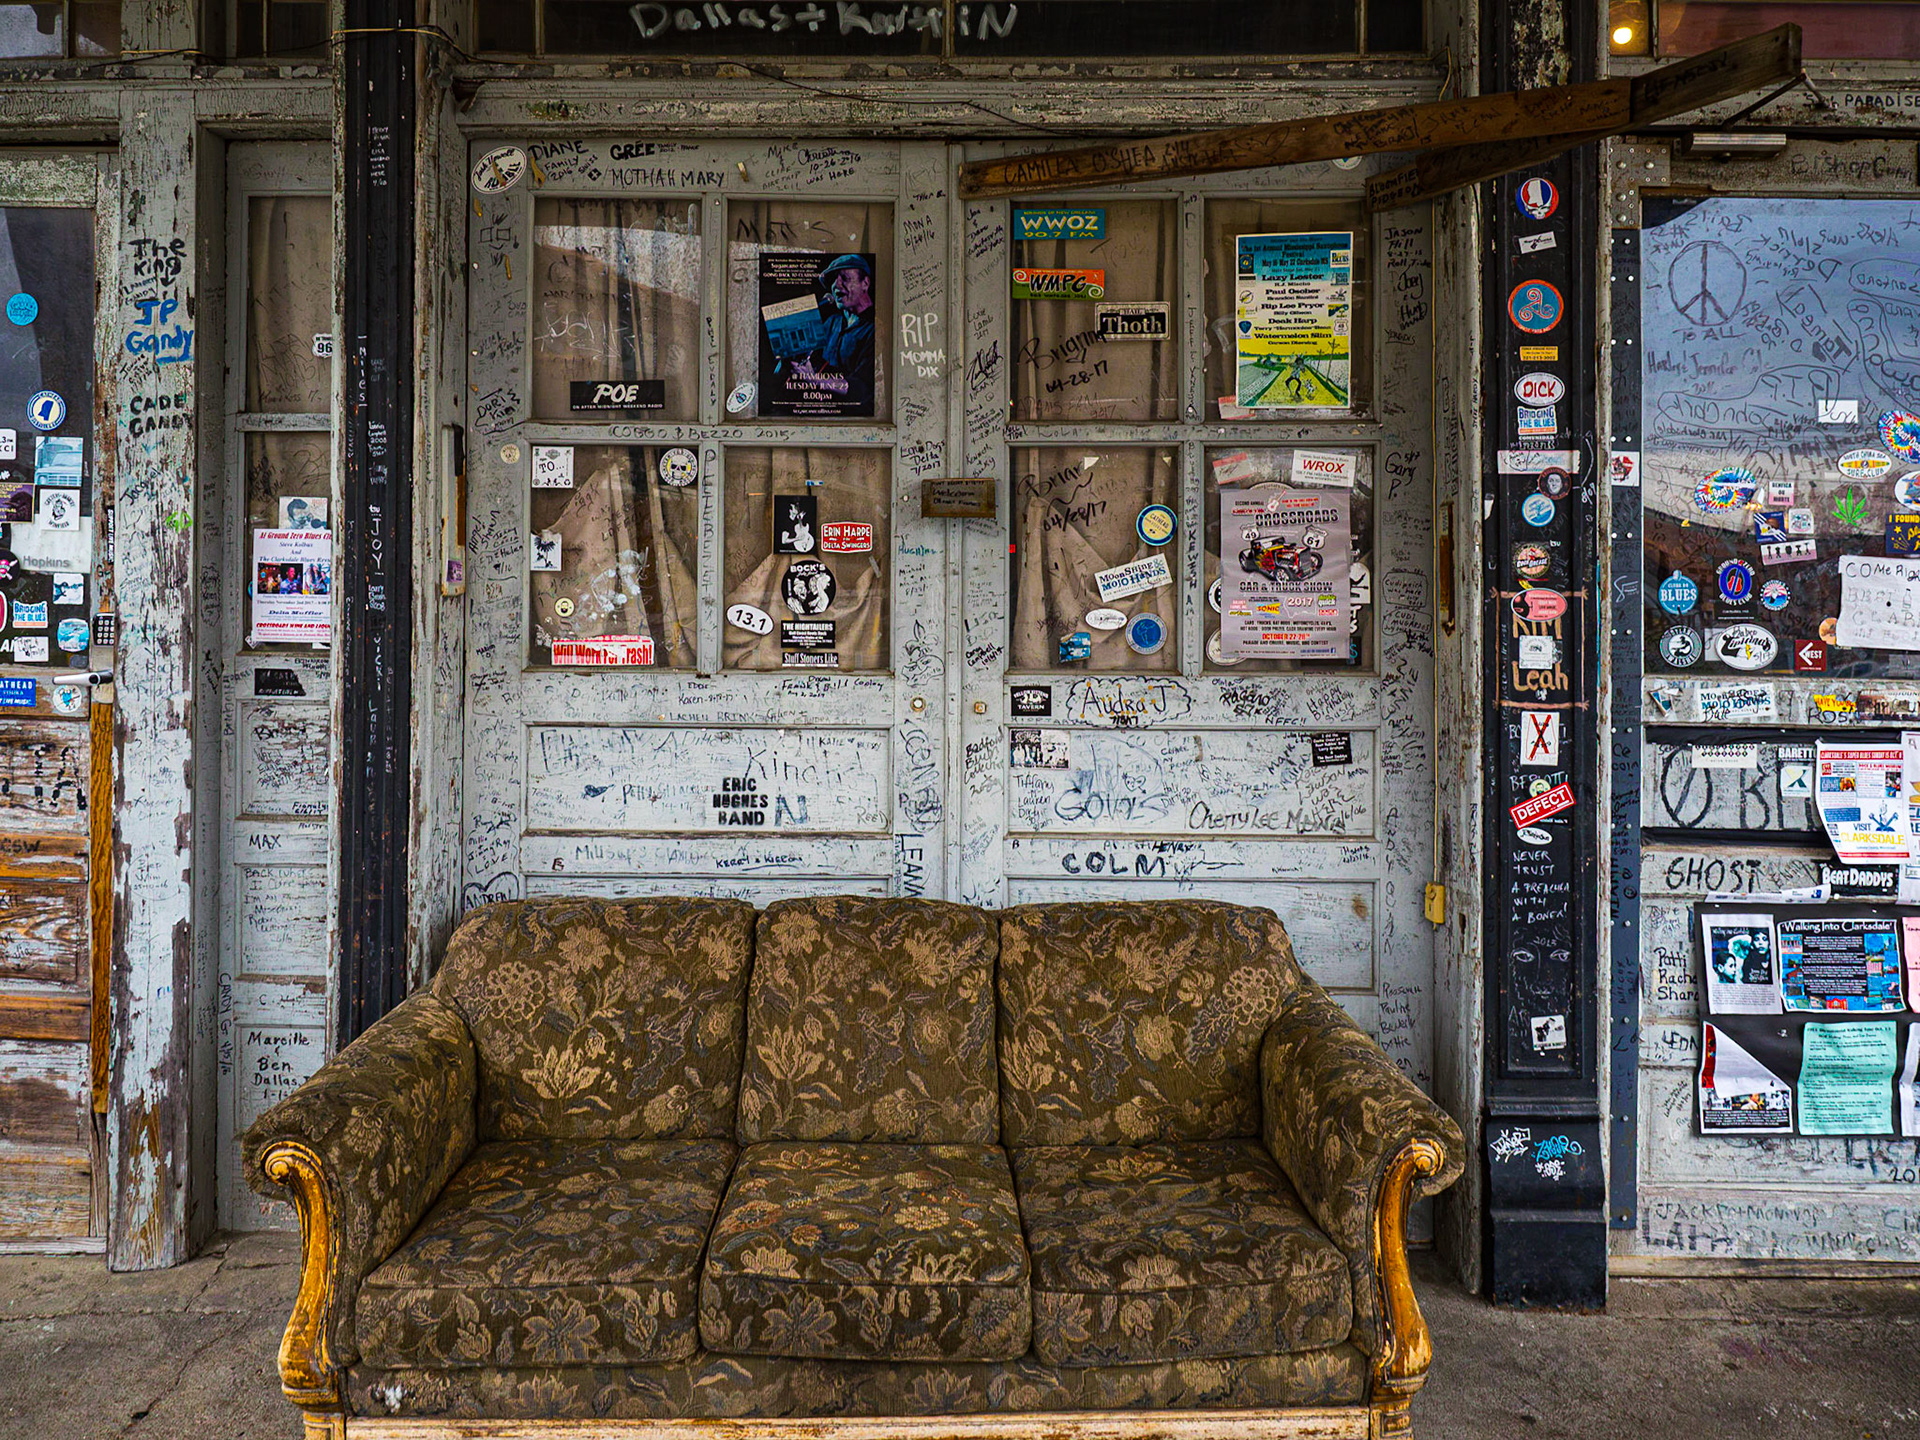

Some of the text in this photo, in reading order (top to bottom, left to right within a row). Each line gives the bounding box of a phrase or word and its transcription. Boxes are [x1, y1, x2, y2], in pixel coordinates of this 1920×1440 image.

[1021, 215, 1098, 231] WWOZ
[128, 238, 187, 258] The
[1030, 274, 1086, 293] WMPG
[1262, 273, 1287, 281] Lazy
[901, 313, 938, 347] RIP
[1103, 317, 1163, 333] Thoth
[317, 342, 332, 354] 96
[917, 365, 940, 378] DIX
[593, 383, 639, 403] POE
[1523, 381, 1556, 398] DICK
[130, 394, 187, 416] CADE
[1519, 406, 1554, 418] BRIDGING
[129, 413, 193, 438] GANDY
[1520, 417, 1556, 427] THE BLUES
[1303, 459, 1345, 474] WROX
[1255, 509, 1339, 527] CROSSROADS
[824, 525, 870, 537] ERIN HARPE
[1245, 531, 1257, 539] 49
[371, 519, 383, 571] JOY
[824, 541, 870, 549] DELTA SWINGERS
[1307, 537, 1320, 547] 61
[23, 555, 70, 568] Hopkins
[790, 563, 827, 573] BOCK'S
[1240, 582, 1258, 592] CAR
[1270, 582, 1301, 592] TRUCK
[1304, 581, 1333, 592] SHOW
[1287, 597, 1314, 607] 2017
[1661, 589, 1697, 602] BLUES
[14, 602, 46, 613] BRIDGING
[15, 613, 46, 622] THE BLUES
[735, 609, 767, 631] 13.1
[783, 623, 794, 631] THE
[554, 644, 602, 664] Will Work
[785, 653, 838, 664] Stuff Stoners Like
[1805, 650, 1822, 659] WEST
[1513, 661, 1568, 691] Leah
[722, 778, 757, 792] ERIC
[712, 793, 769, 808] HUGHES
[1517, 789, 1567, 821] DEFECT
[718, 810, 765, 826] BAND
[1853, 823, 1871, 831] VISIT
[249, 834, 281, 850] MAX
[1841, 832, 1905, 845] CLARKSDALE
[1513, 851, 1551, 863] NEVER
[1062, 852, 1167, 877] COLM
[1513, 865, 1554, 875] TRUST
[1665, 857, 1762, 893] GHOST
[1822, 866, 1893, 888] BEAT DADDYS
[1514, 897, 1546, 906] WITH
[1822, 922, 1840, 933] Into
[1653, 947, 1688, 968] Patti
[257, 1057, 292, 1073] Ben
